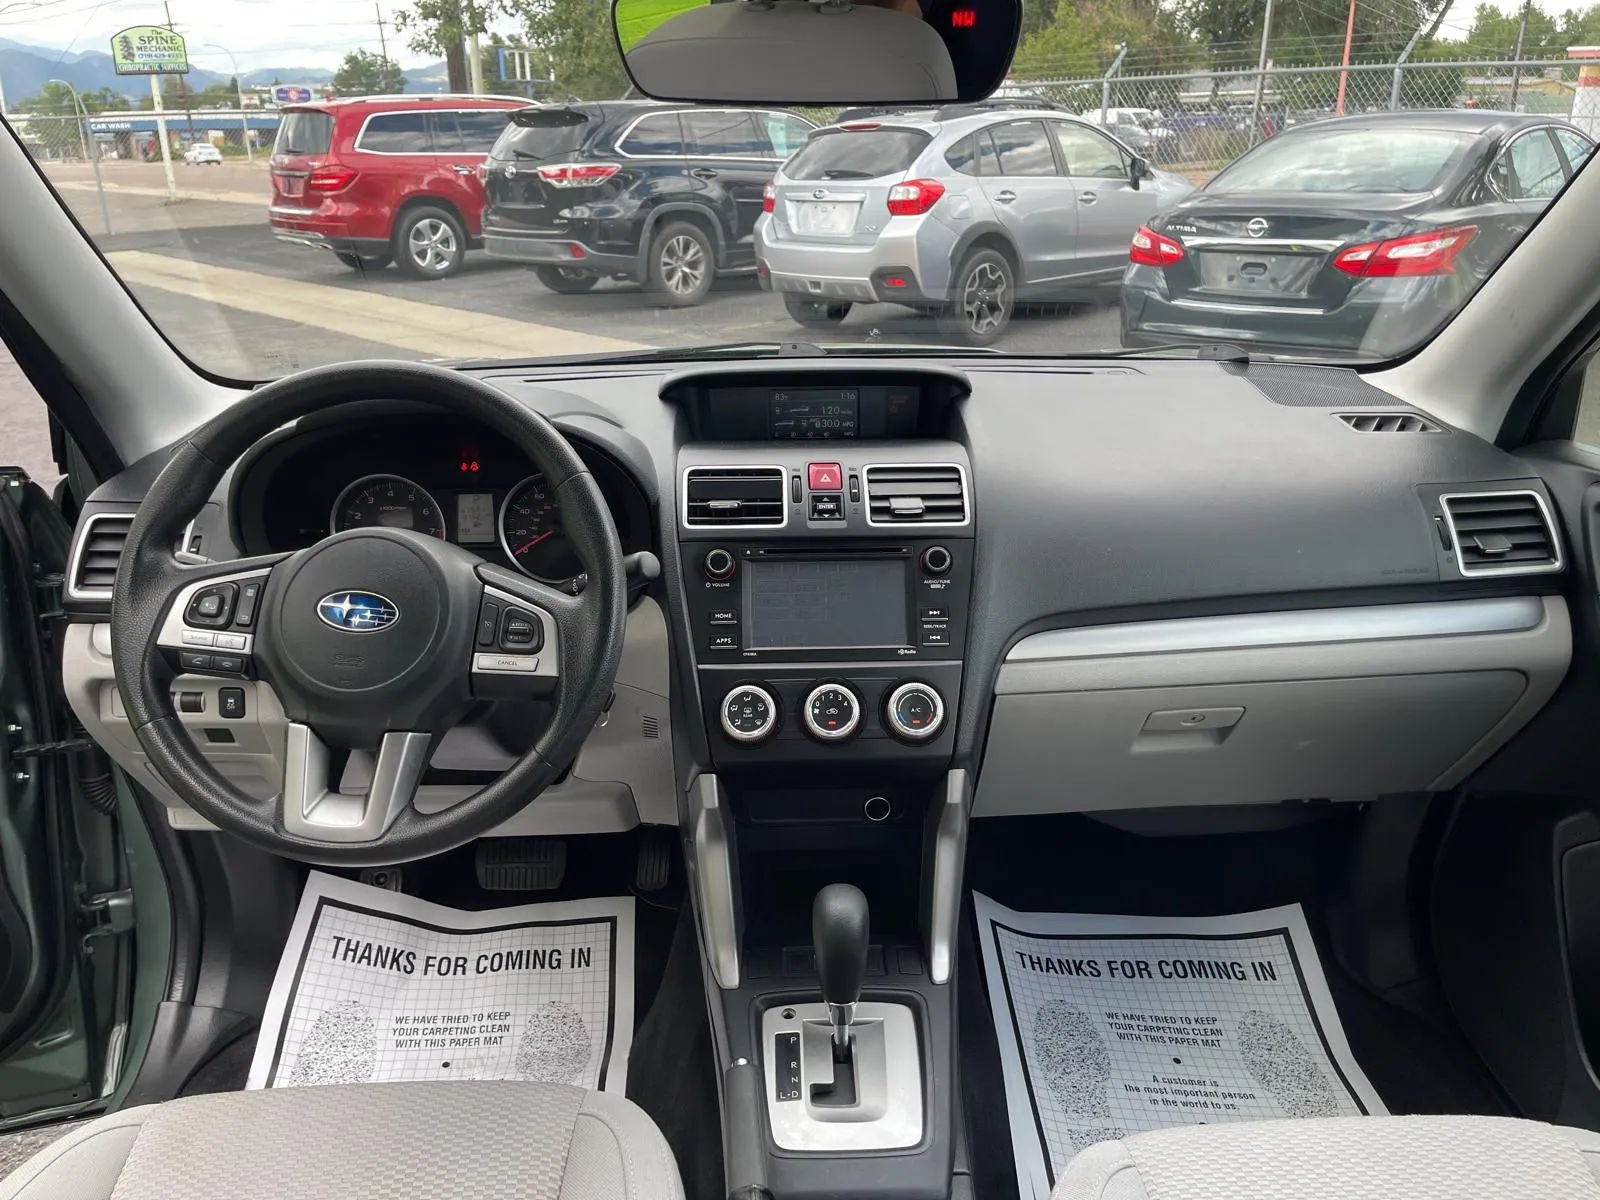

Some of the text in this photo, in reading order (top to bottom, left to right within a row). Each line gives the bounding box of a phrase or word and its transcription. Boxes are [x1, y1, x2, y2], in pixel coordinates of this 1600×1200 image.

[951, 10, 976, 27] NW
[138, 35, 178, 45] SPINE
[118, 63, 160, 72] CHIROPRACTIC
[822, 406, 840, 415] 120
[408, 494, 415, 502] 5
[354, 512, 361, 520] 2
[332, 935, 591, 976] THANKS FOR COMING IN
[1015, 951, 1278, 982] THANKS FOR COMING IN
[395, 1011, 511, 1024] WE HAVE TRIED TO KEEP
[1105, 1011, 1218, 1025] WE HAVE TRIED TO KEEP
[392, 1024, 510, 1036] YOUR CARPETING CLEAN
[1108, 1021, 1223, 1037] YOUR CARPETING CLEAN
[395, 1036, 504, 1048] WITH THIS PAPER MAT
[790, 1036, 797, 1044] P
[1116, 1032, 1222, 1048] WITH THIS PAPER MAT
[790, 1061, 798, 1069] R
[1152, 1074, 1220, 1087] A customer is
[1124, 1084, 1256, 1101] the most important person
[1149, 1097, 1160, 1106] in
[1161, 1097, 1178, 1107] the
[1181, 1099, 1209, 1109] world
[1211, 1101, 1222, 1110] to
